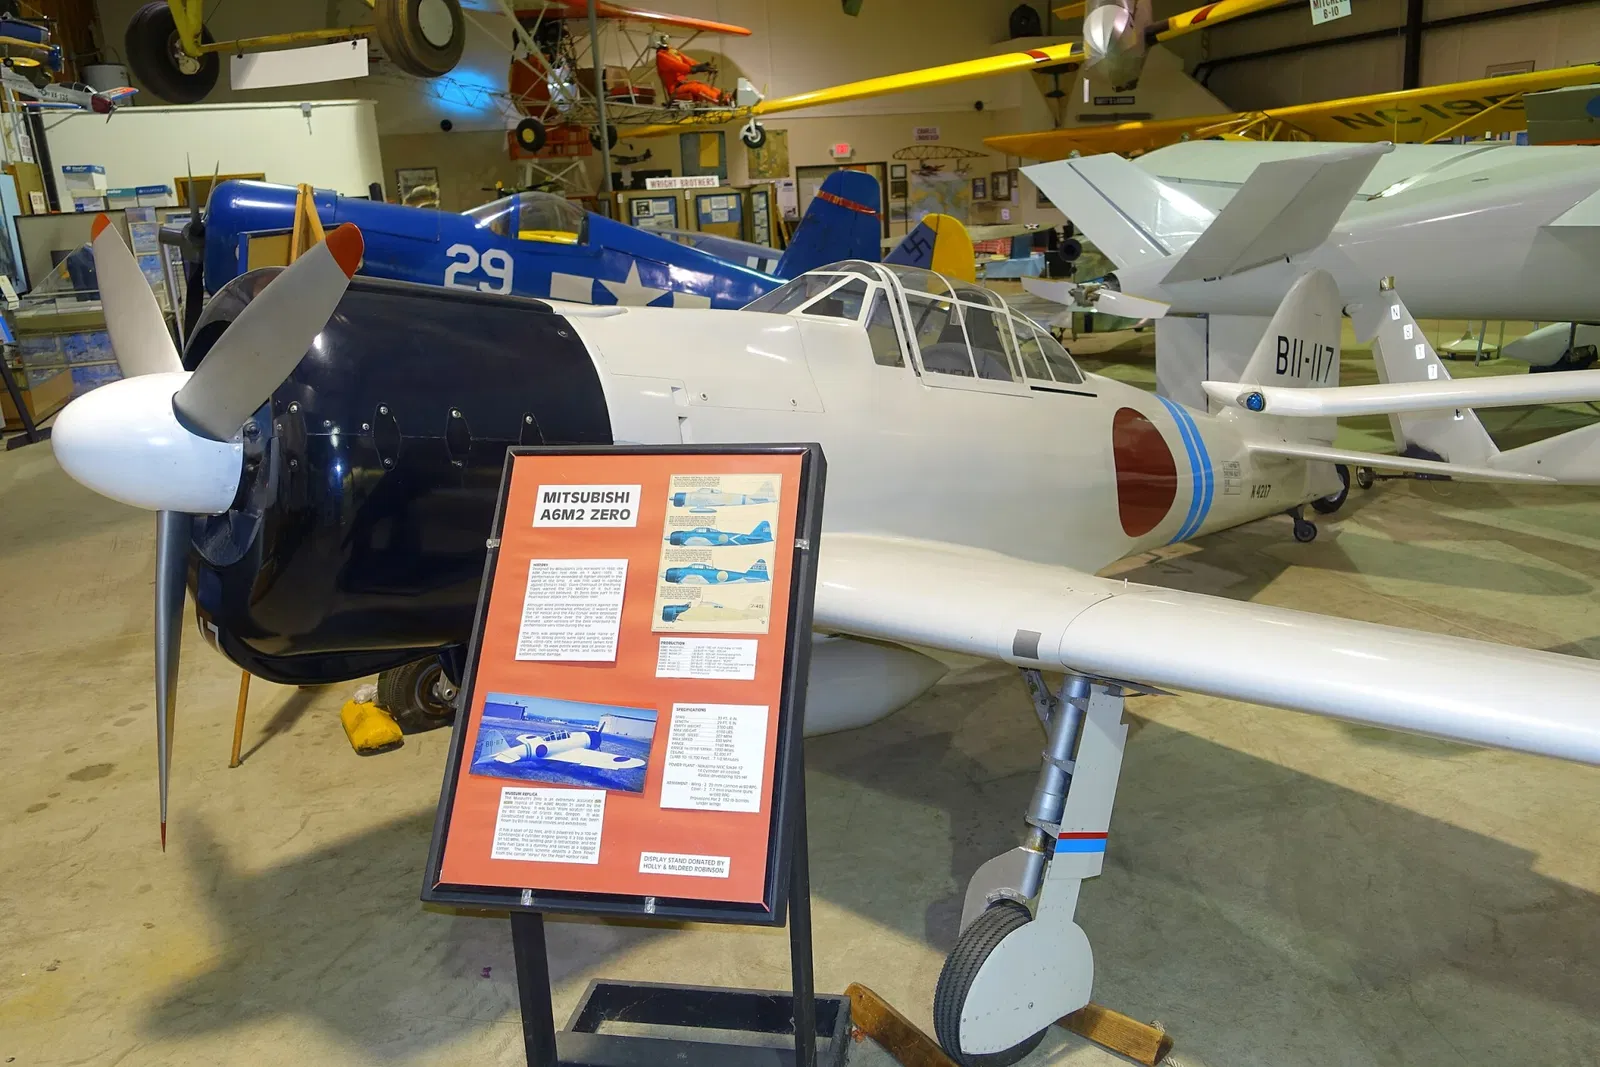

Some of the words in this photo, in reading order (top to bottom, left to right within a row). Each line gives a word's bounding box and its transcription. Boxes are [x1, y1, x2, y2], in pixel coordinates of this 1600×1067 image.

[650, 180, 676, 188] WRIGHT
[680, 178, 716, 187] BROTHERS
[444, 244, 514, 295] 29
[543, 492, 630, 504] MITSUBISHI
[540, 508, 584, 521] A6M2
[590, 508, 631, 521] ZERO
[688, 858, 715, 866] DONATED
